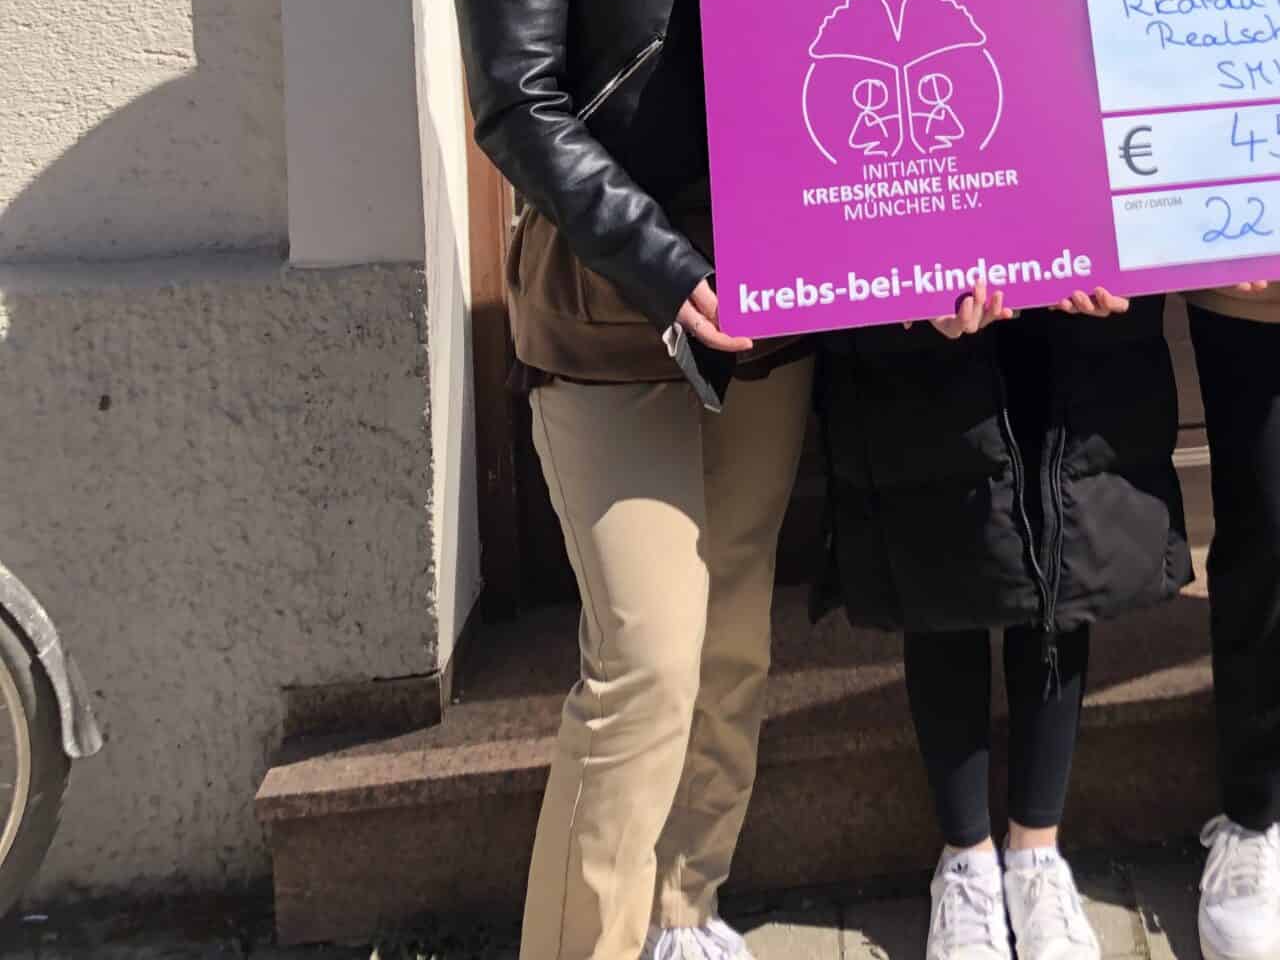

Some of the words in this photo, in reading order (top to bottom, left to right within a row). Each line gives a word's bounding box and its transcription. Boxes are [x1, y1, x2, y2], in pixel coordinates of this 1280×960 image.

[862, 156, 958, 181] INITIATIVE
[802, 176, 943, 207] KREBSKRANKE
[947, 168, 1018, 191] KINDER
[844, 193, 946, 222] MÜNCHEN
[951, 191, 983, 211] E.V.
[738, 248, 1092, 314] krebs-bei-kindern.de
